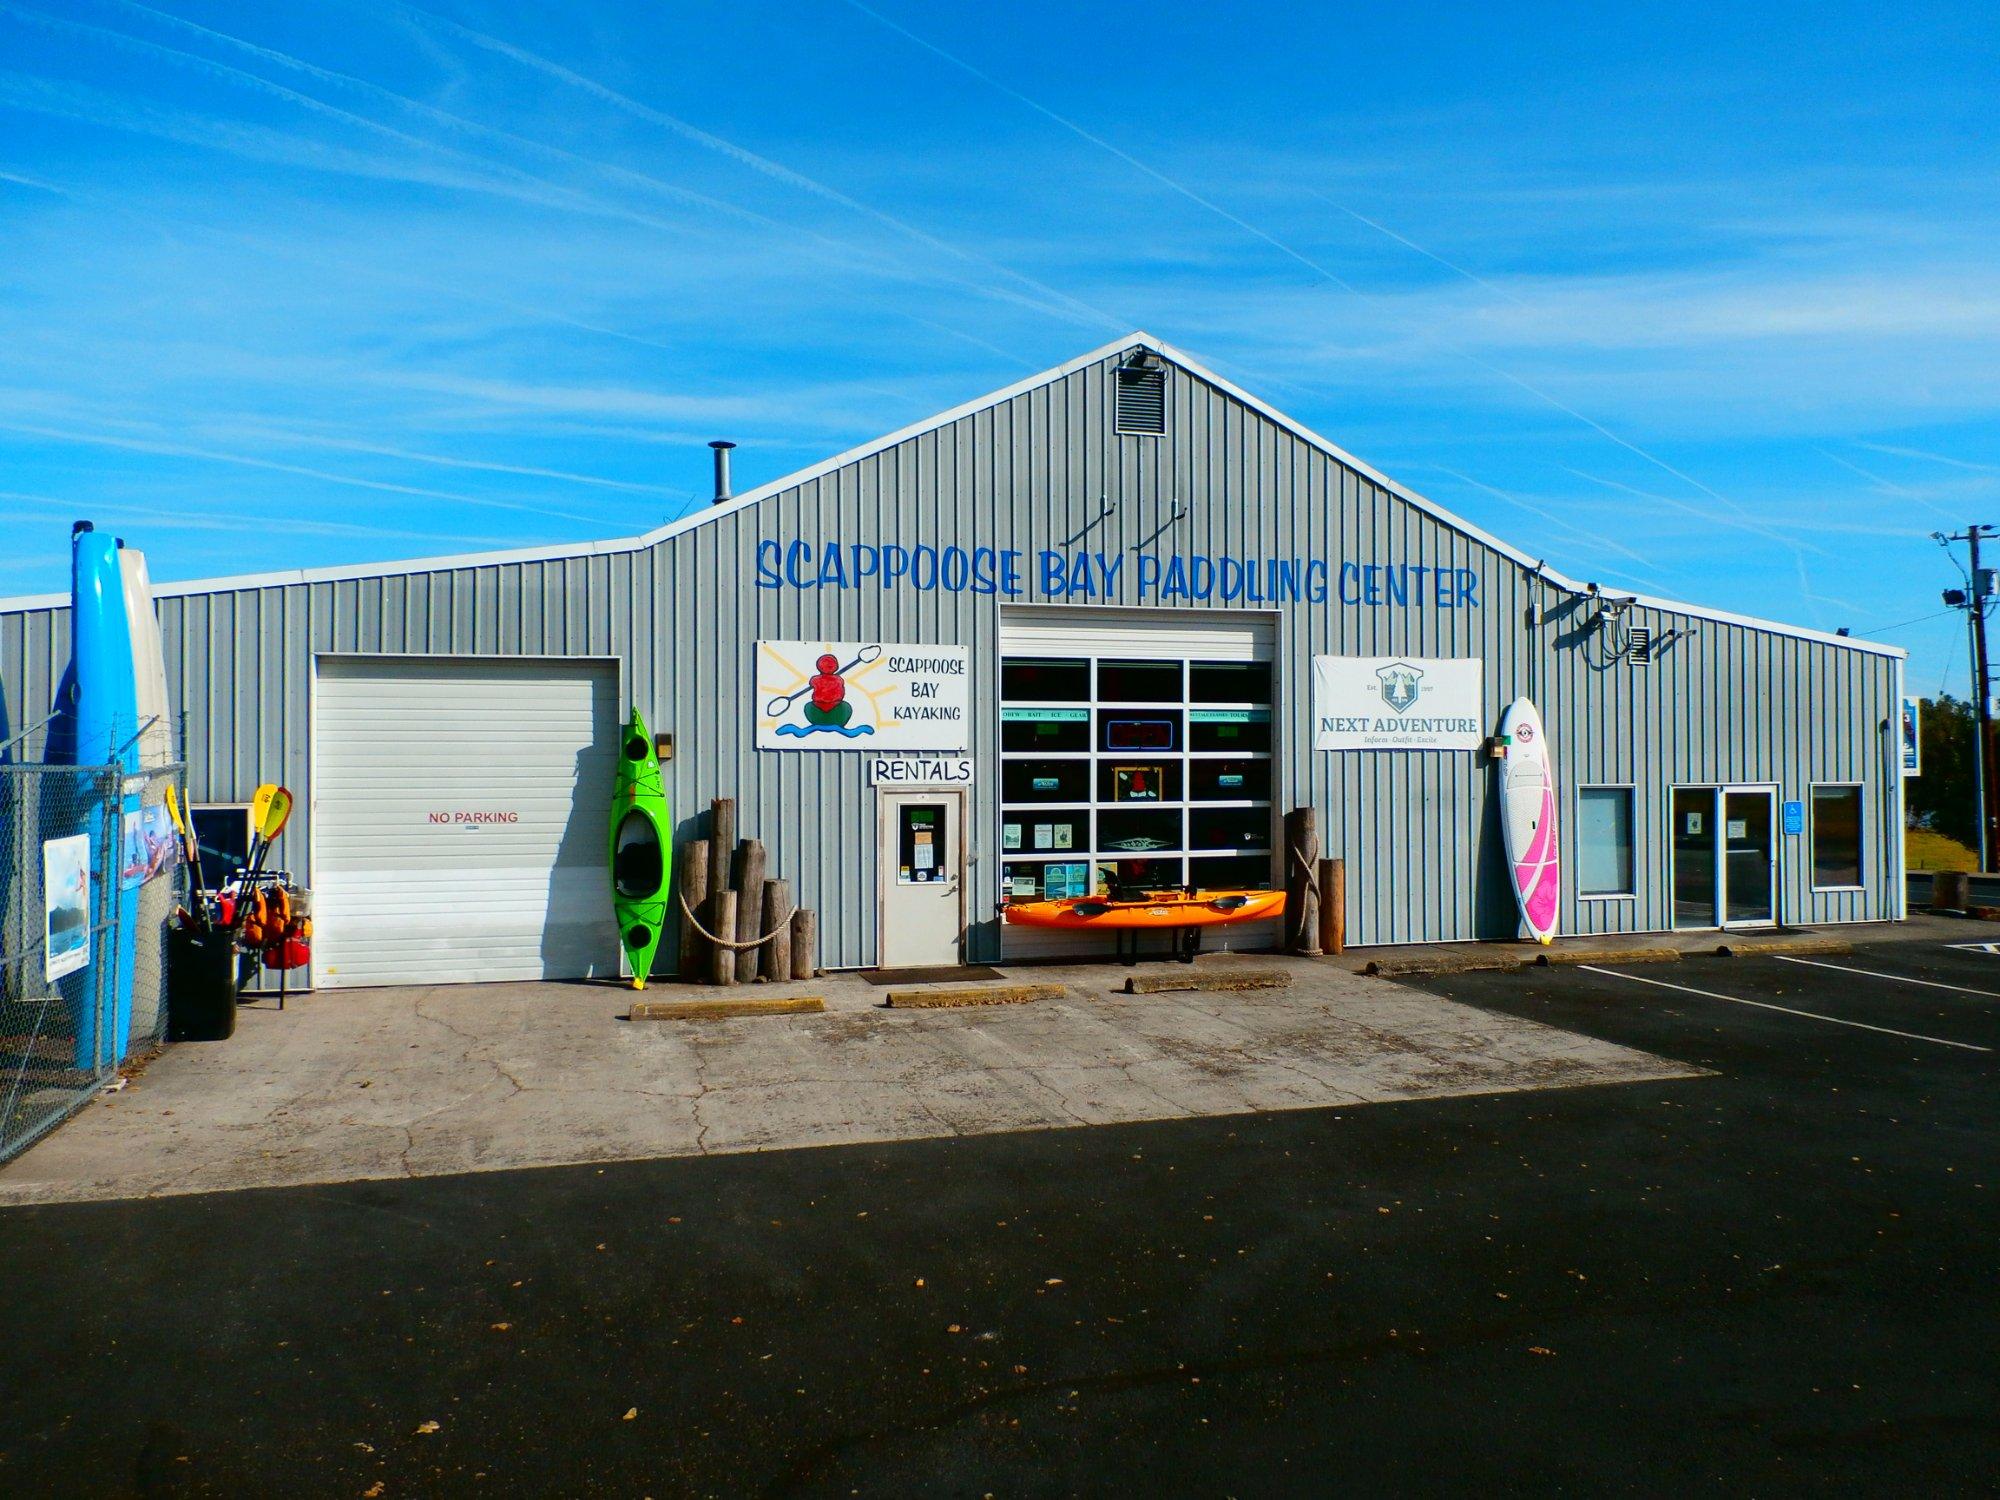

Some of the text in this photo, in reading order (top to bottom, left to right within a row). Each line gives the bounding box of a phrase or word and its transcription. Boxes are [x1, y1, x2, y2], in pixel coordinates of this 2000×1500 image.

[755, 539, 1479, 608] SCAPPOOSE BAY PADDLING CENTER
[888, 656, 965, 675] SCAPPOOSE
[911, 681, 940, 698] BAY
[893, 706, 961, 720] KAYAKING
[1321, 717, 1477, 733] NEXT ADVENTURE
[1392, 735, 1412, 744] Outfit
[876, 760, 970, 781] RENTALS
[429, 812, 518, 823] NO PARKING
